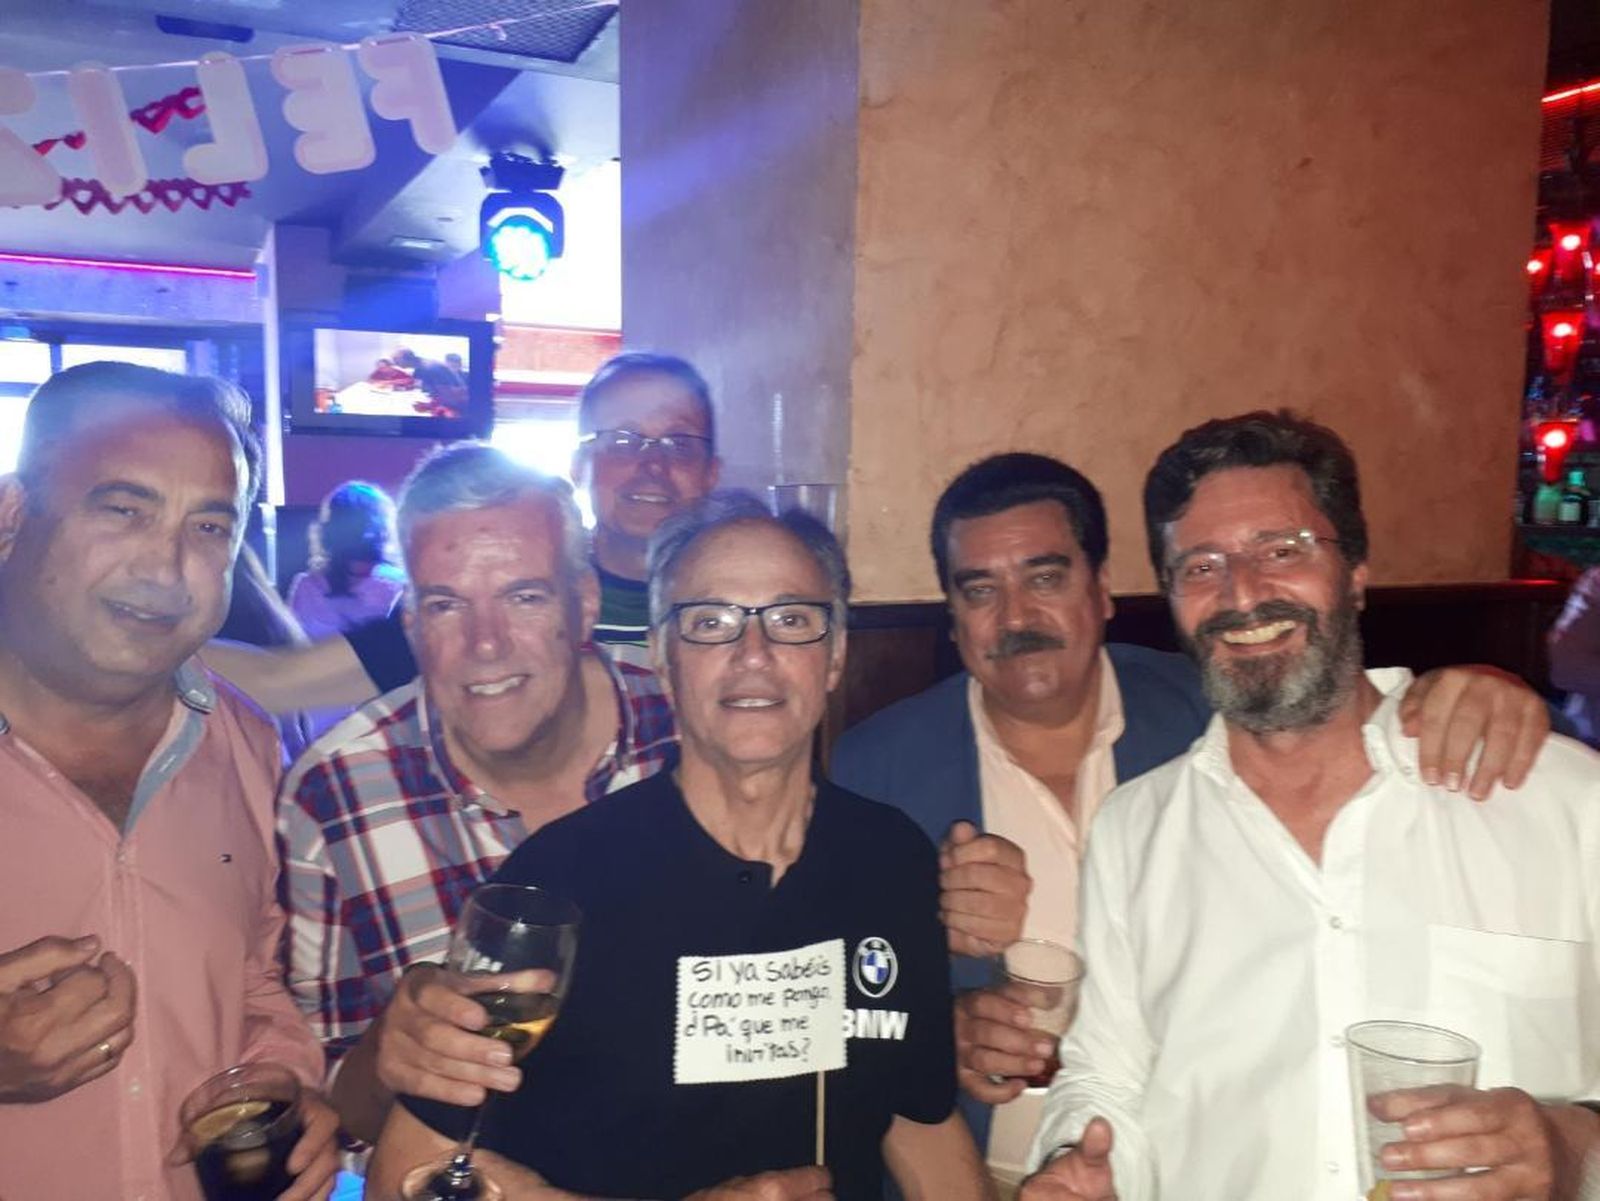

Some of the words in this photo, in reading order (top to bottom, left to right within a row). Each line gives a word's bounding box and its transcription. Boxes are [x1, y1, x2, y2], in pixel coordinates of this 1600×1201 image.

[748, 992, 776, 1006] me
[781, 1016, 809, 1032] me
[840, 1008, 910, 1041] BMW
